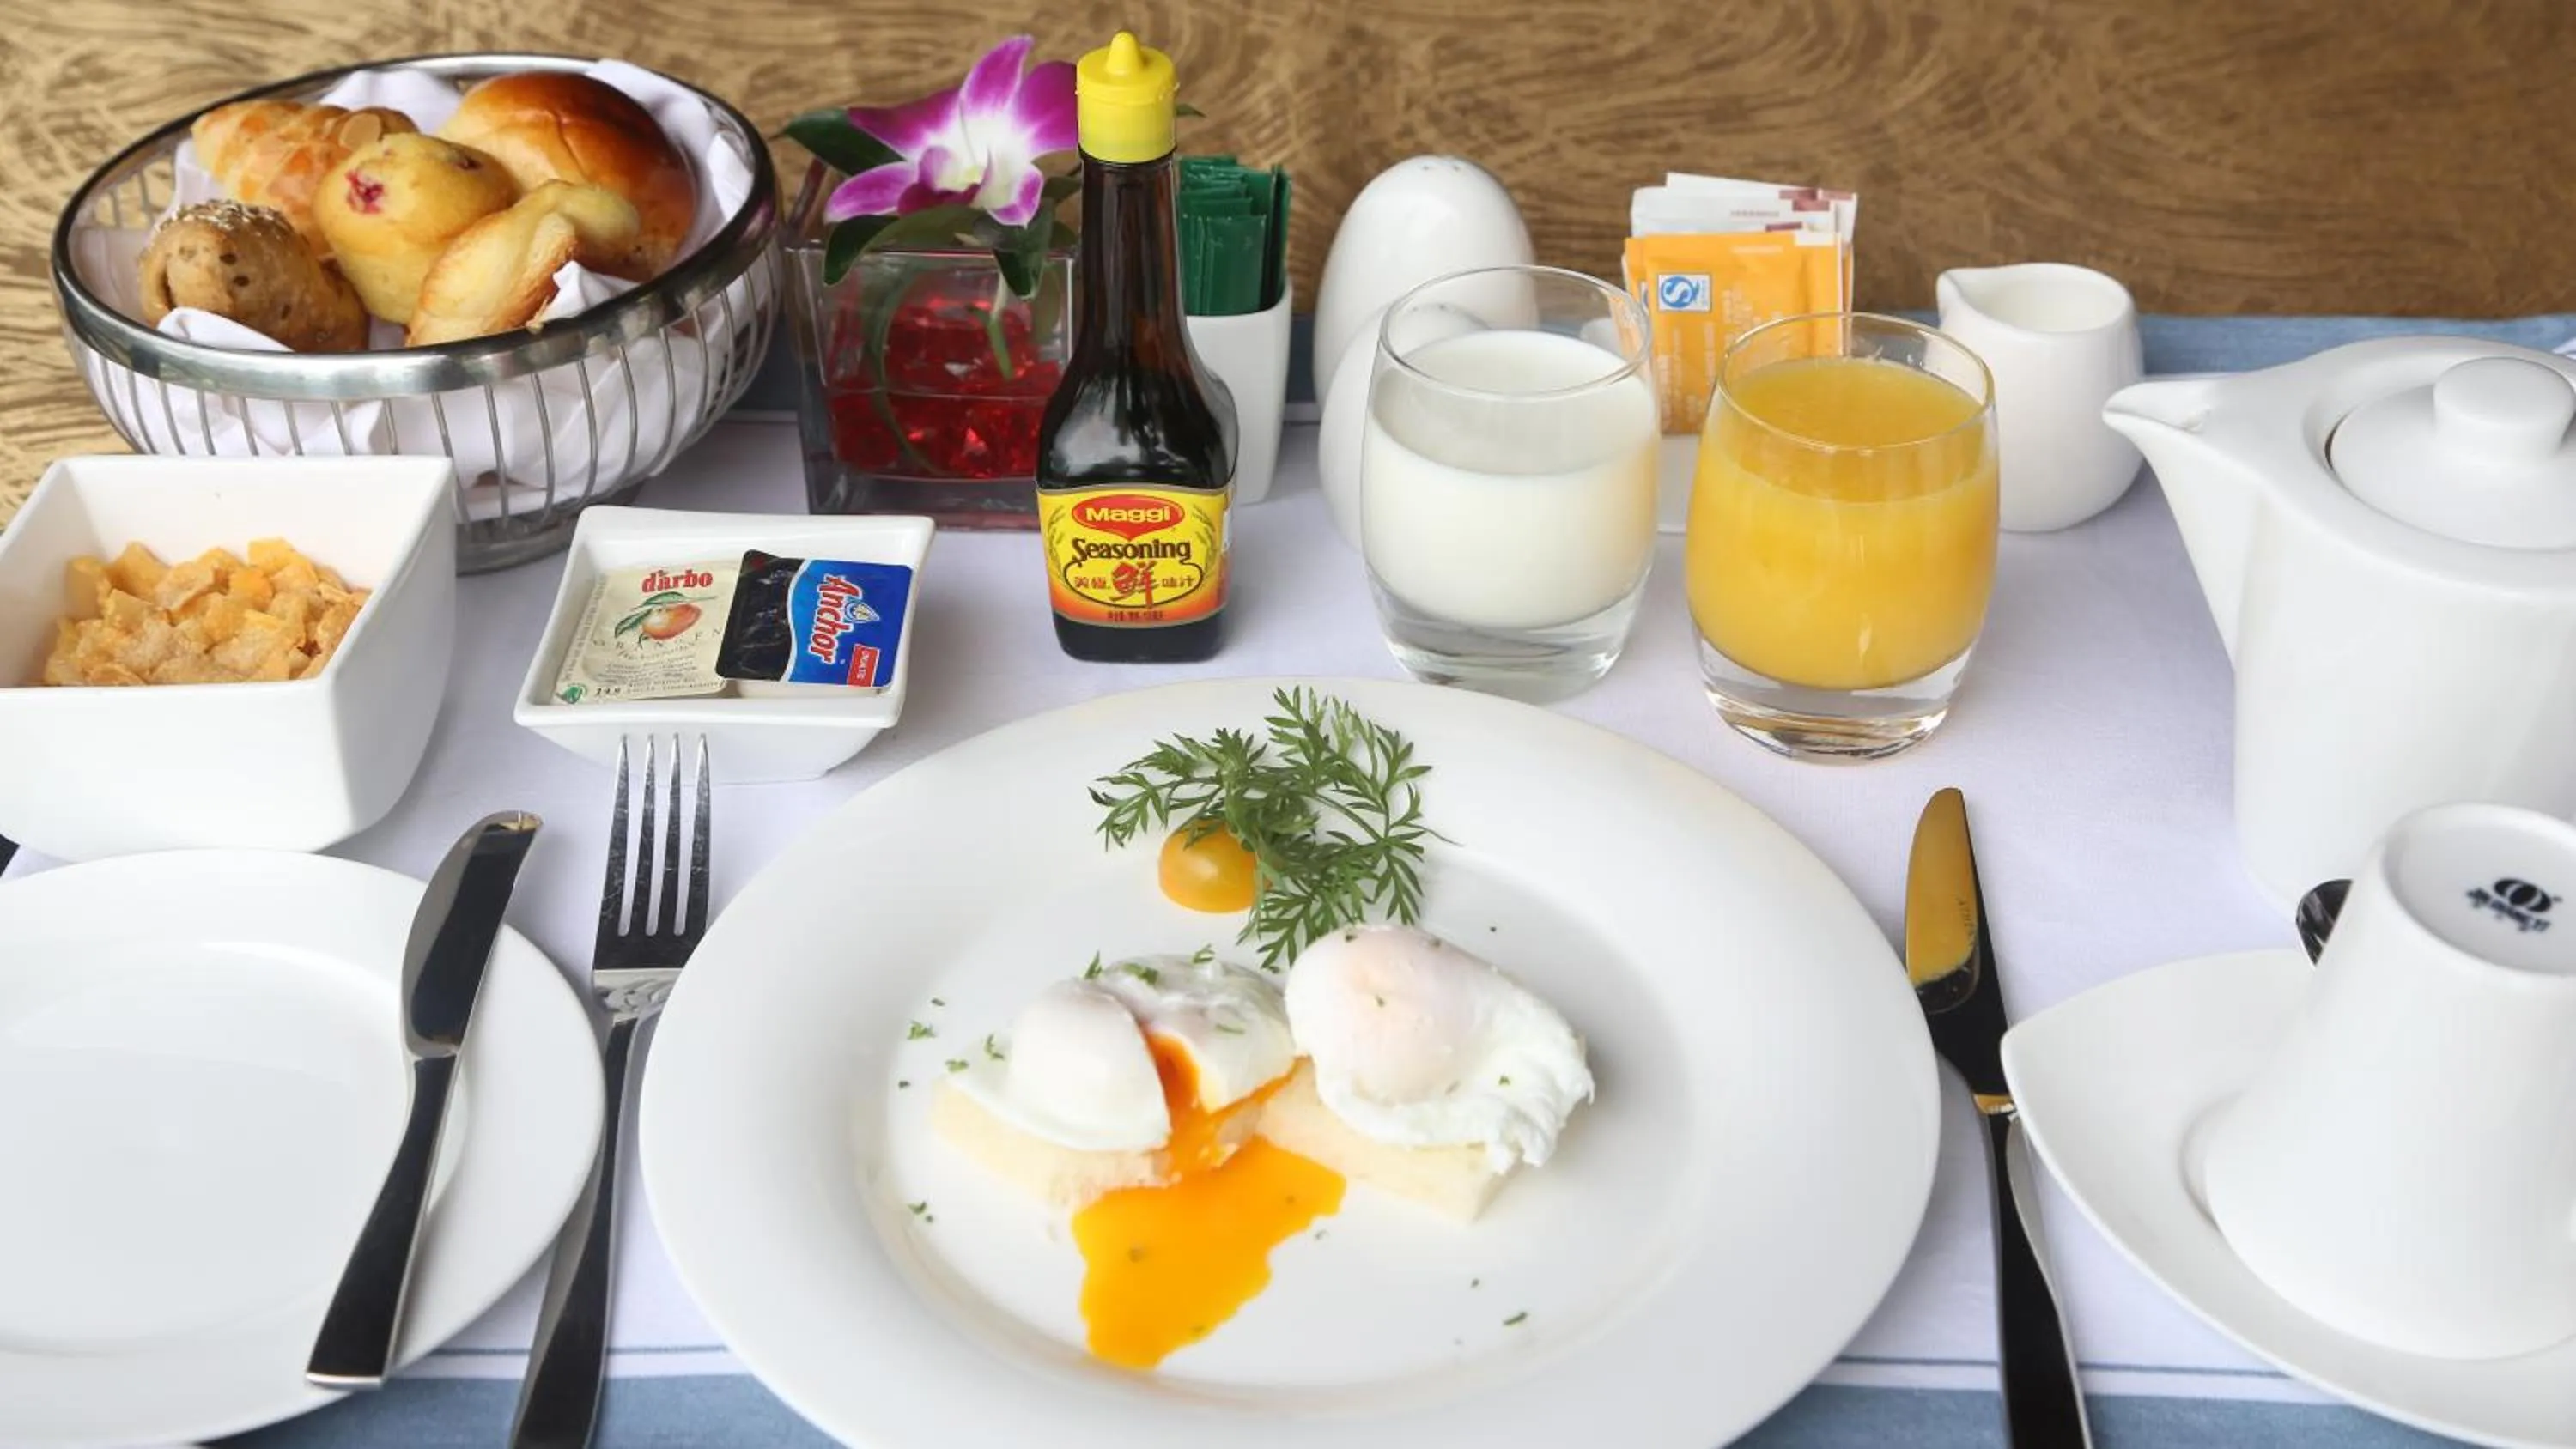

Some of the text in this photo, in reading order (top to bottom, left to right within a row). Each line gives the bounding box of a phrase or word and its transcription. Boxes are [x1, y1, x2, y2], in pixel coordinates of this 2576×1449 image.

[1085, 506, 1170, 523] Maggi
[1072, 537, 1191, 564] Seasoning
[808, 573, 862, 664] Anchor
